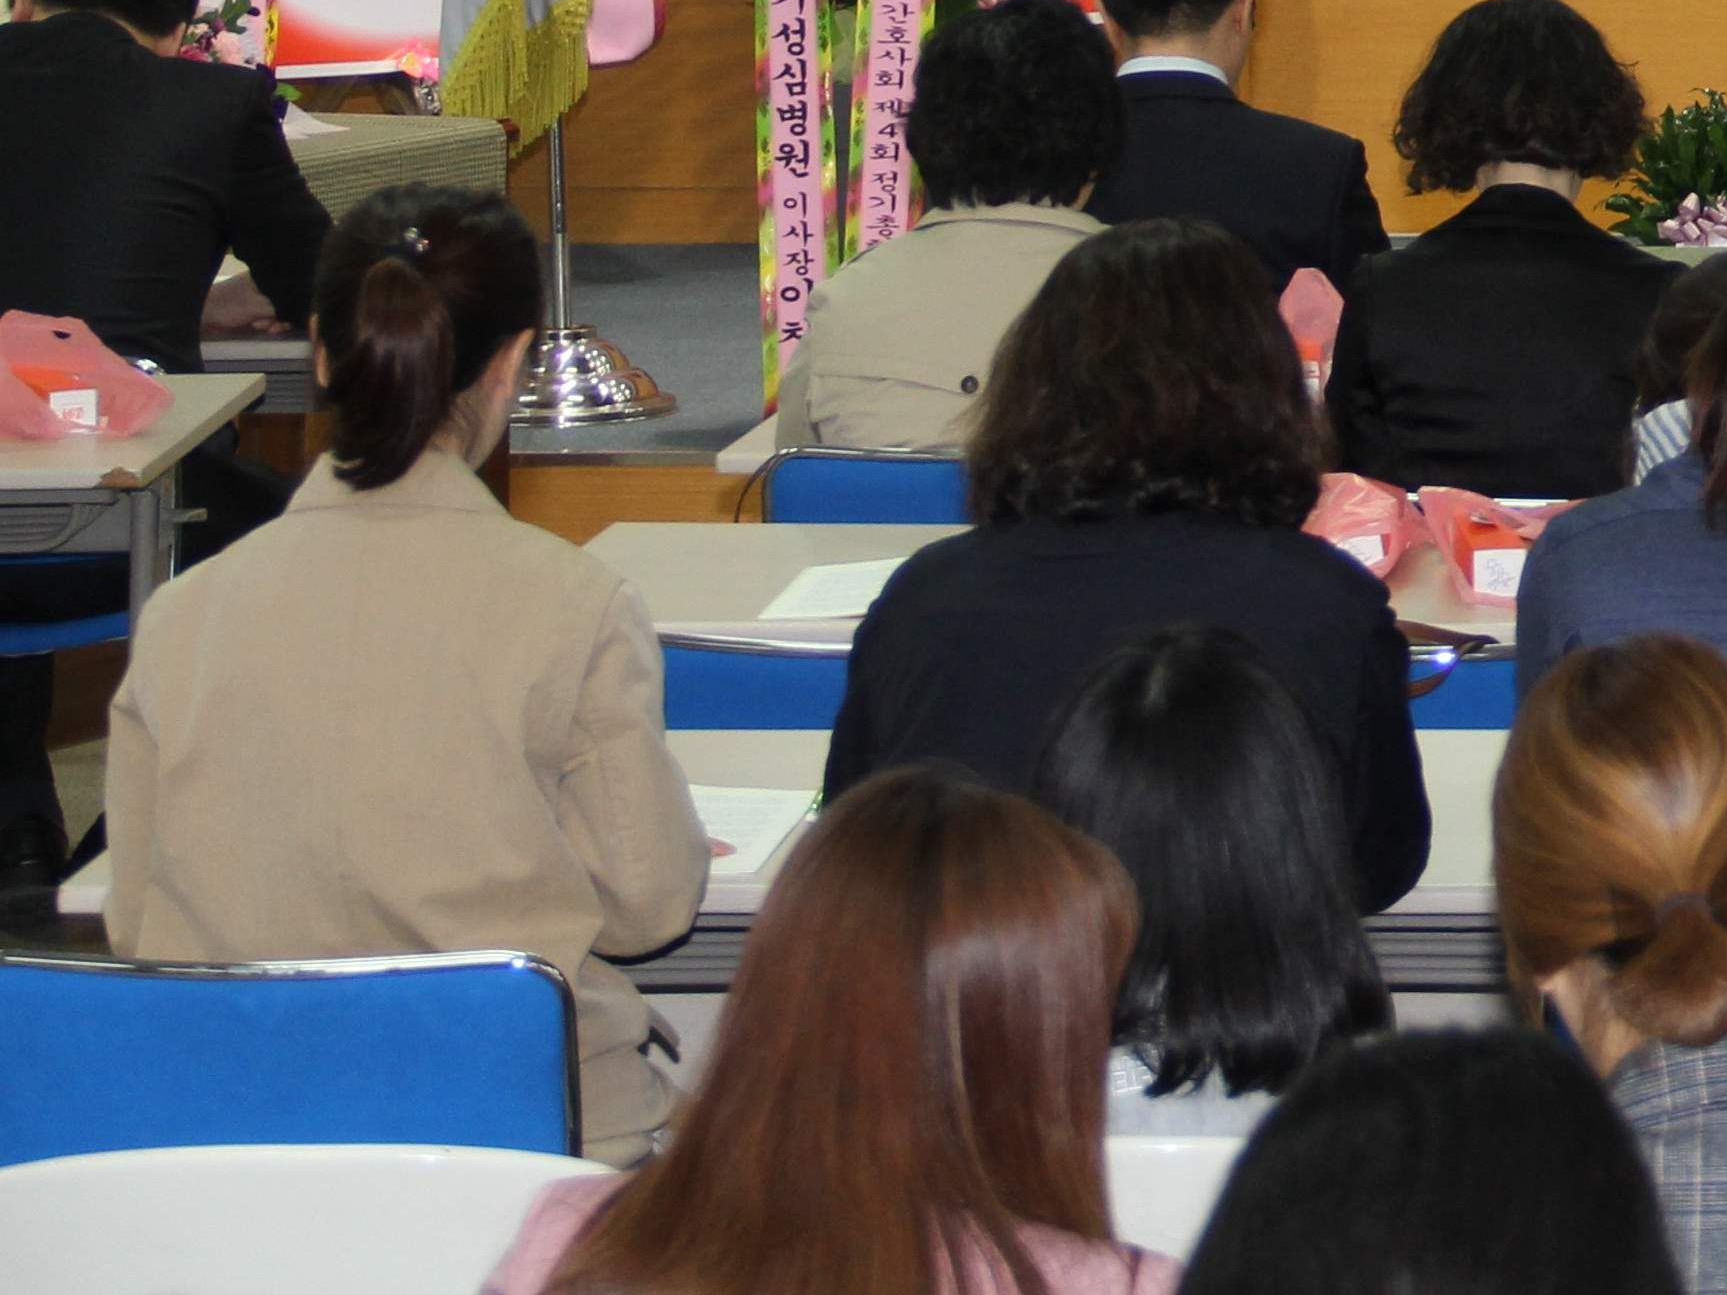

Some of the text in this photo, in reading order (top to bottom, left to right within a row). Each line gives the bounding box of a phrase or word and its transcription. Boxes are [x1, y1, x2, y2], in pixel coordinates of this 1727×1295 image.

[874, 2, 916, 90] 간호사회
[869, 98, 904, 163] 제4회
[782, 191, 815, 277] 이사장
[866, 170, 901, 247] 정기총
